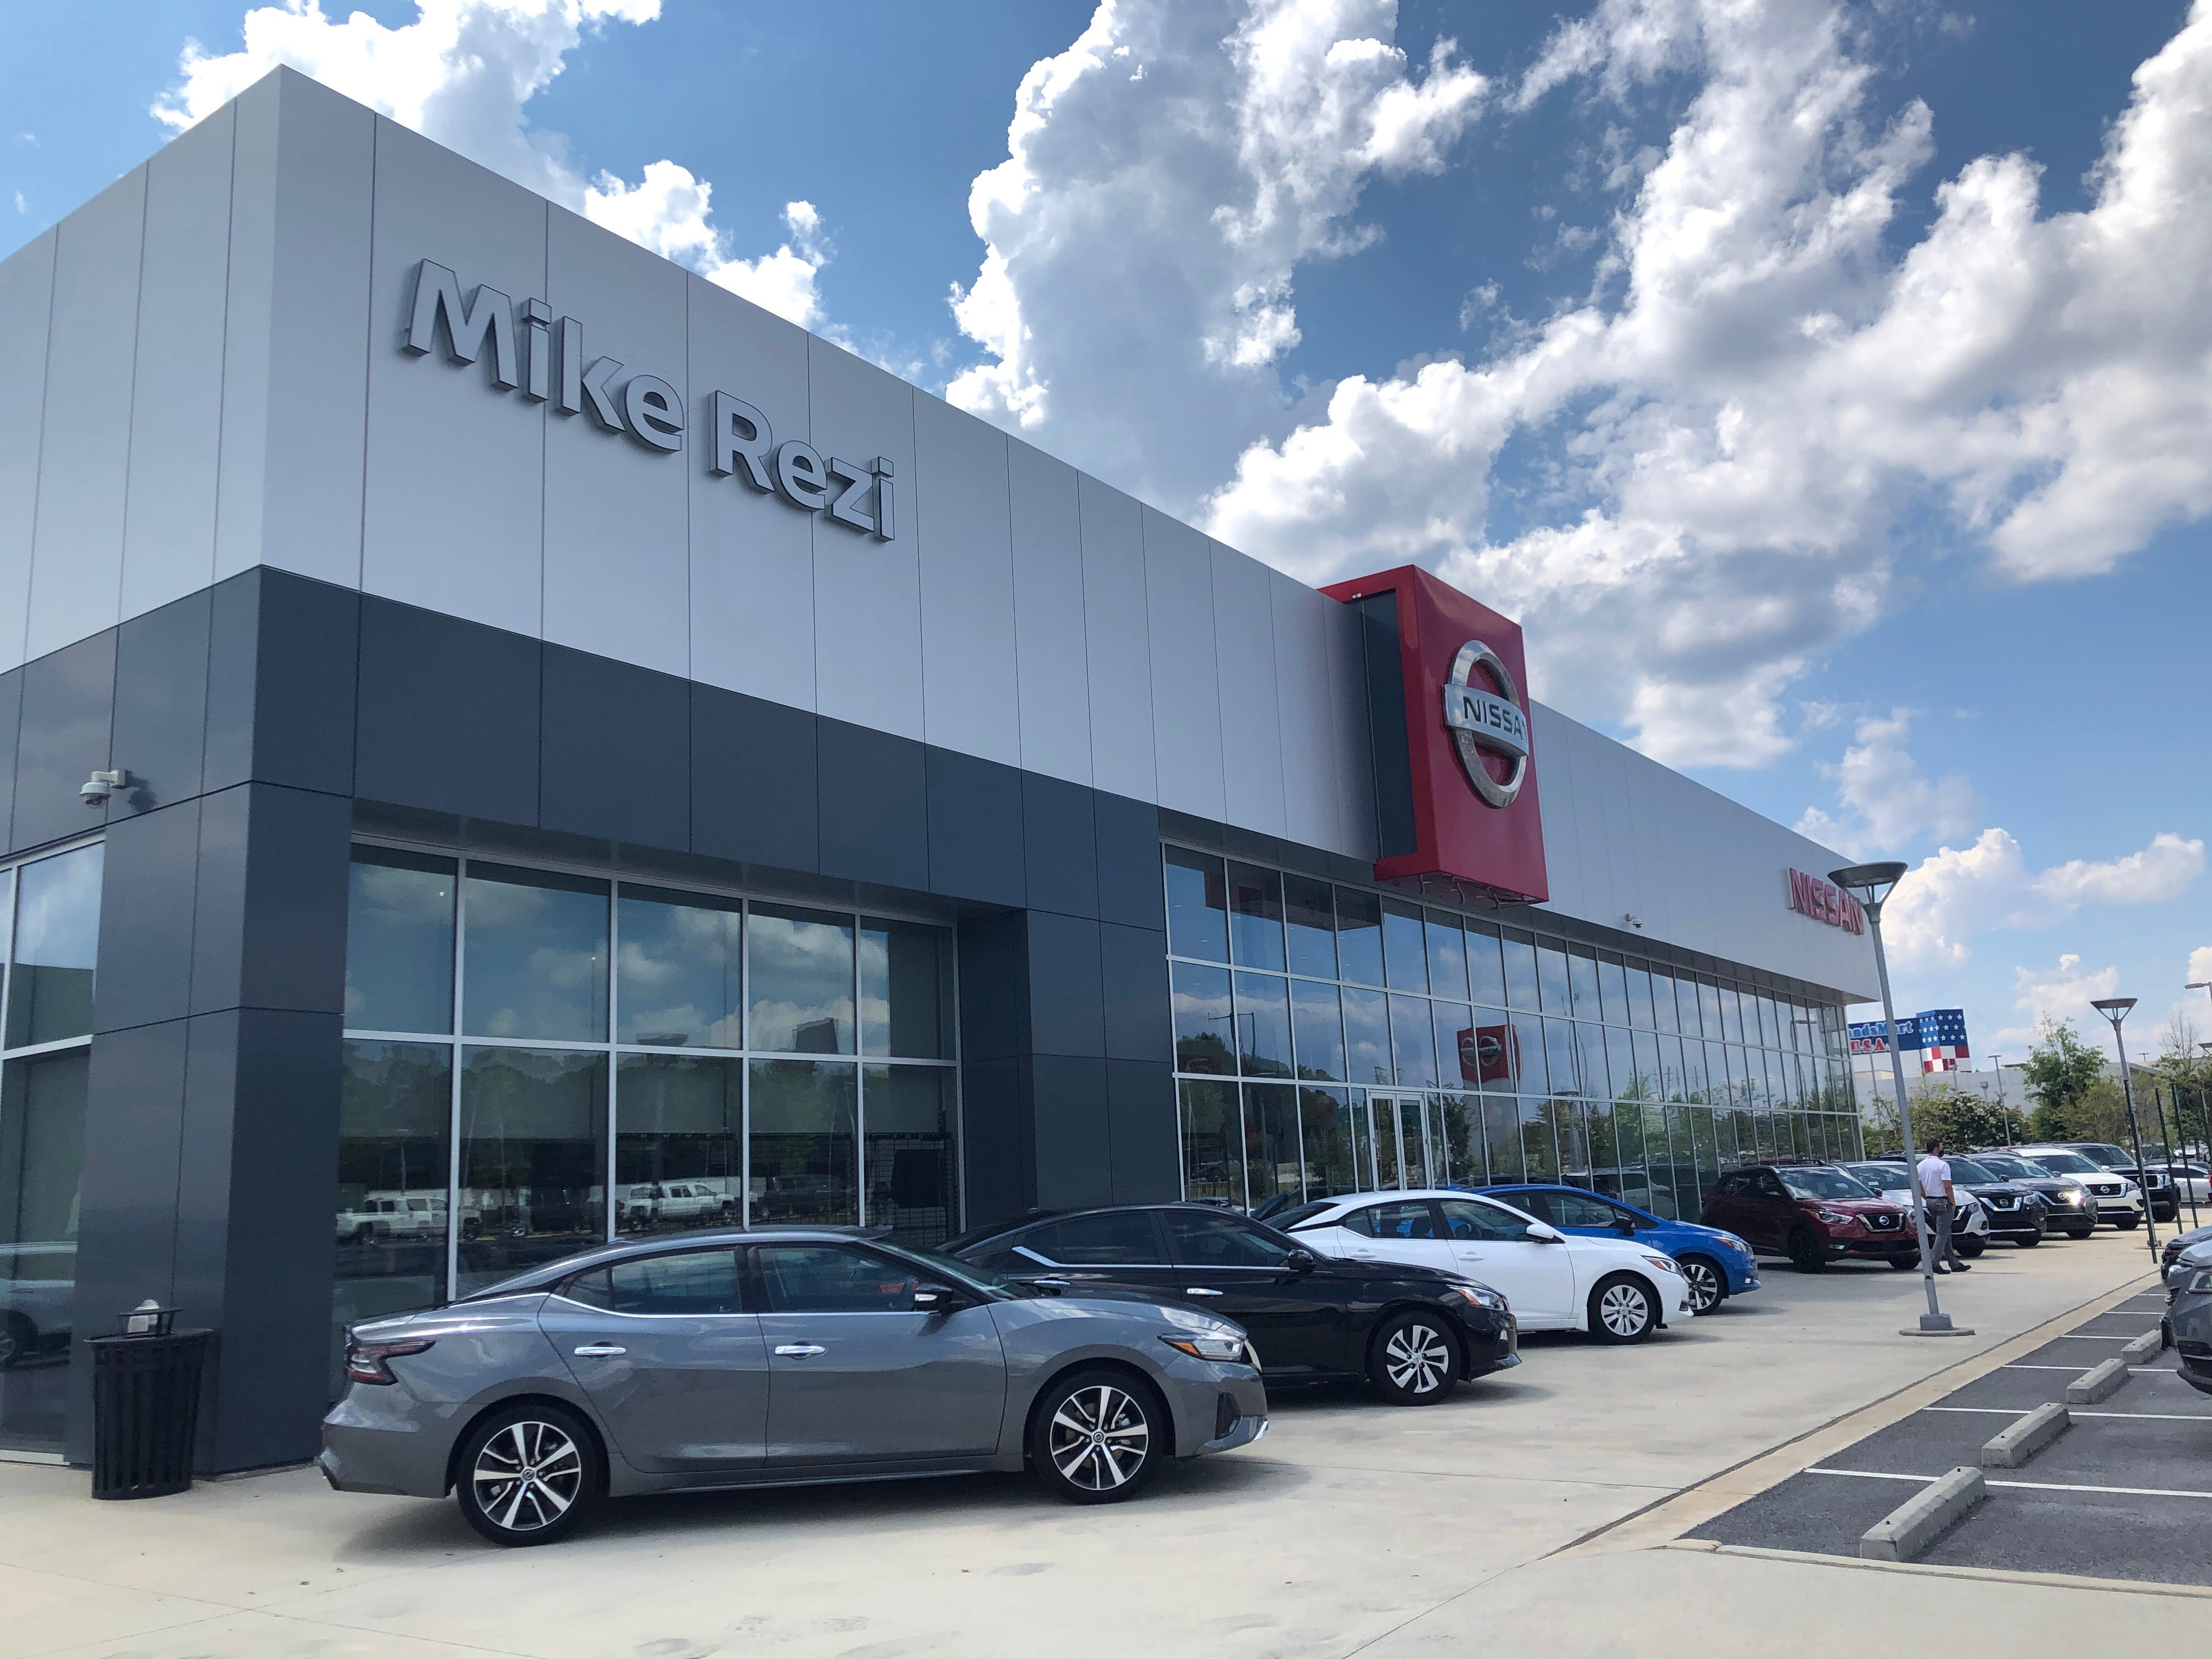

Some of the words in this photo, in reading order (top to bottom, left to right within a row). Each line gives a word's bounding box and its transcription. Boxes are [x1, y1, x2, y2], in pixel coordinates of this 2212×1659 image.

[401, 258, 684, 454] Mike
[708, 390, 895, 542] Rezi
[1786, 866, 1865, 935] NISSAN
[1849, 1020, 1914, 1039] ndsMrt
